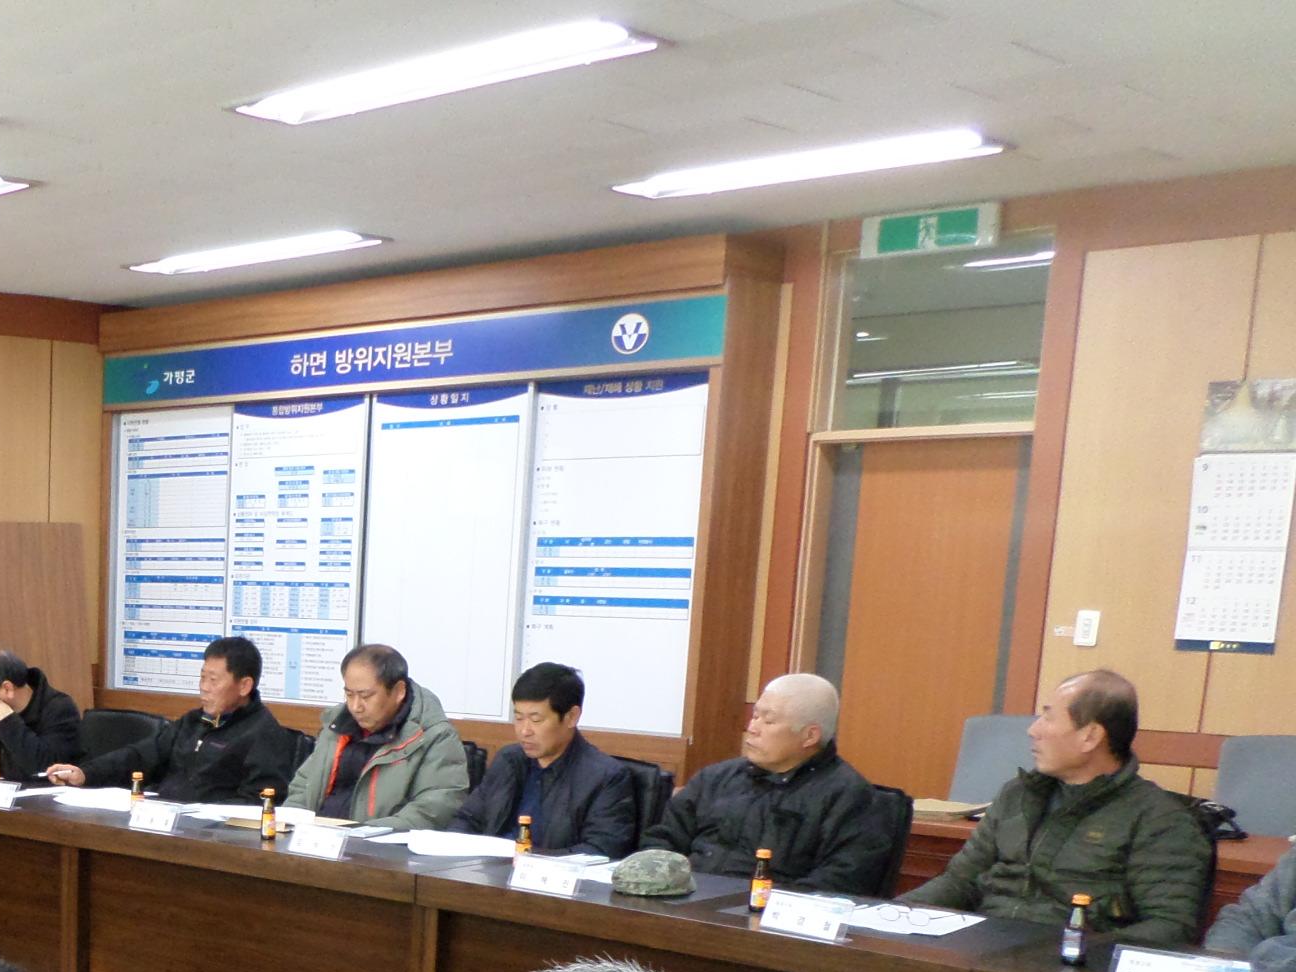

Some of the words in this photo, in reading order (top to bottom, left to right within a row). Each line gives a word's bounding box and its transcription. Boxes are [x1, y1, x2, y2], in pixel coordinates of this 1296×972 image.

[290, 352, 327, 377] 하면
[335, 340, 454, 375] 방위지원본부
[163, 370, 195, 385] 가평군
[430, 392, 470, 405] 상황일지
